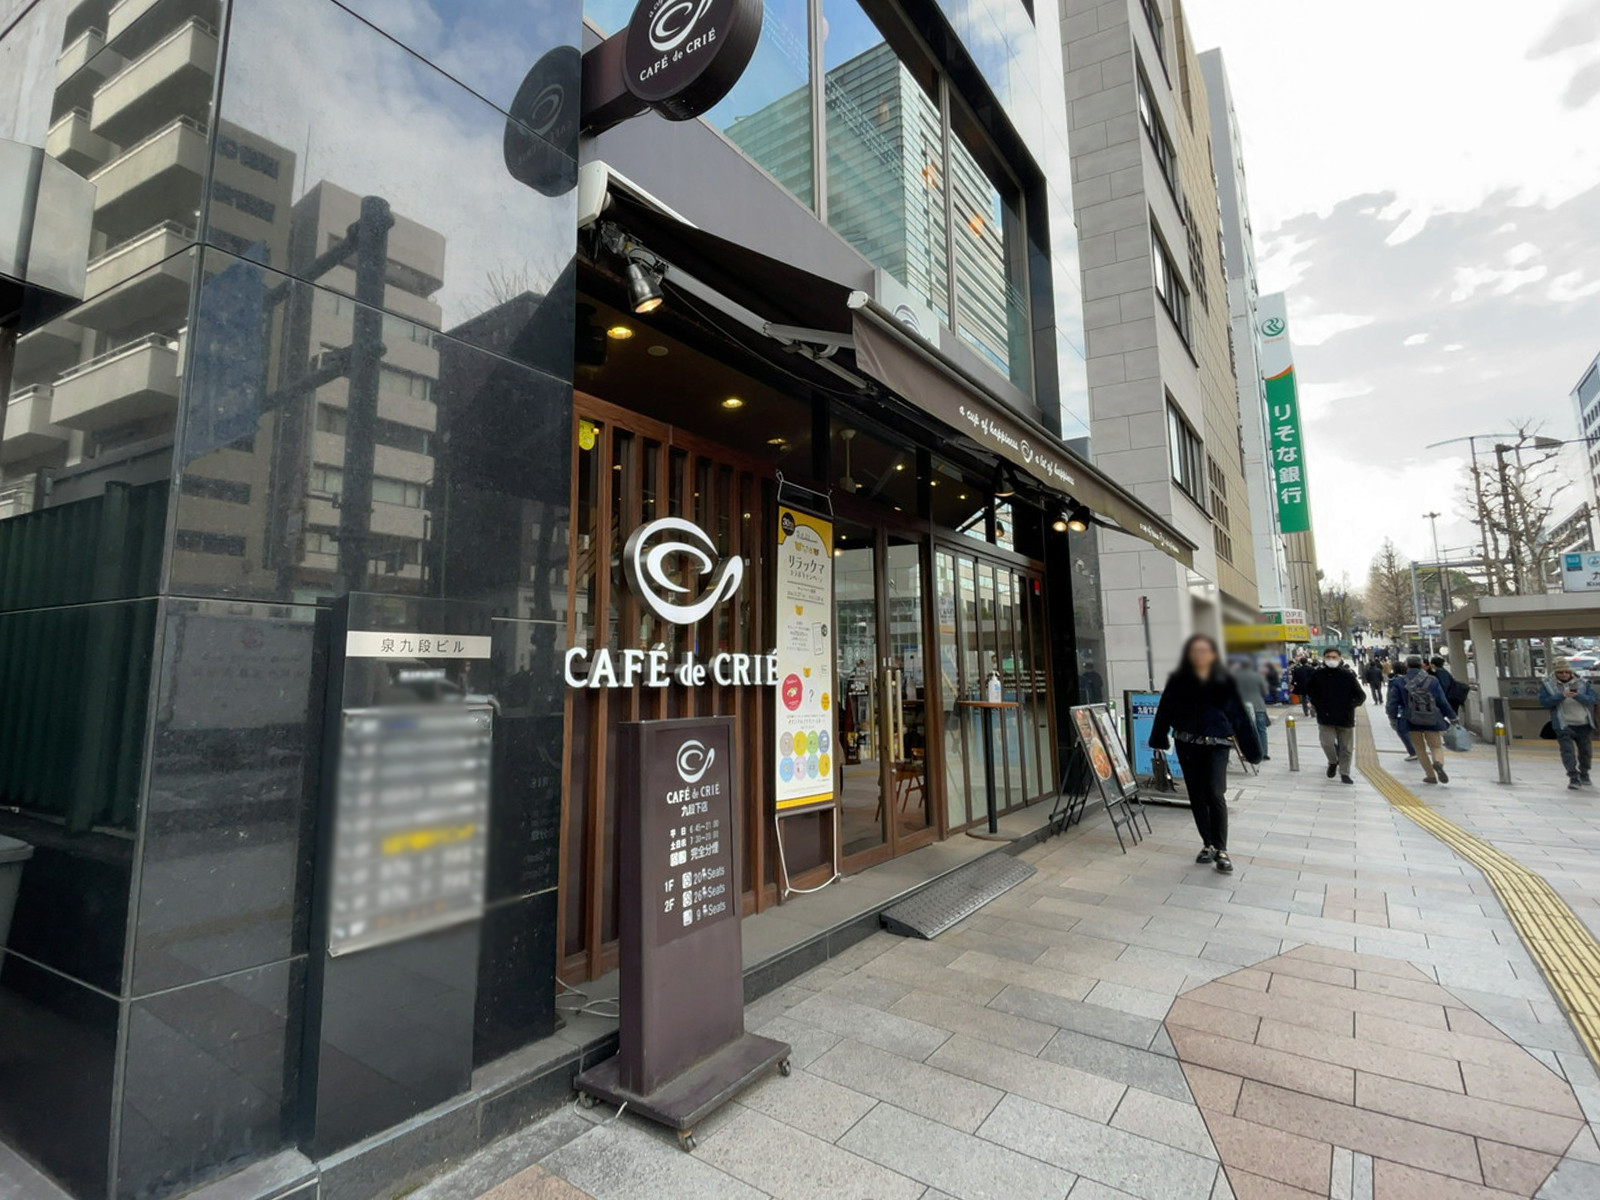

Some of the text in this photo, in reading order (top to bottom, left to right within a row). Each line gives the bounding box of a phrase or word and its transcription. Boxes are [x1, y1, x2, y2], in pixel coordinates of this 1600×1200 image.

[639, 27, 717, 82] CAFÉ de CRIÉ
[1273, 403, 1302, 505] りそな銀行
[380, 638, 466, 655] 泉九段ビル
[564, 641, 779, 689] CAFÉ de CRIÉ
[666, 782, 720, 804] CAFÉ de CRIÉ
[664, 878, 674, 893] 1F
[664, 898, 675, 913] 2F
